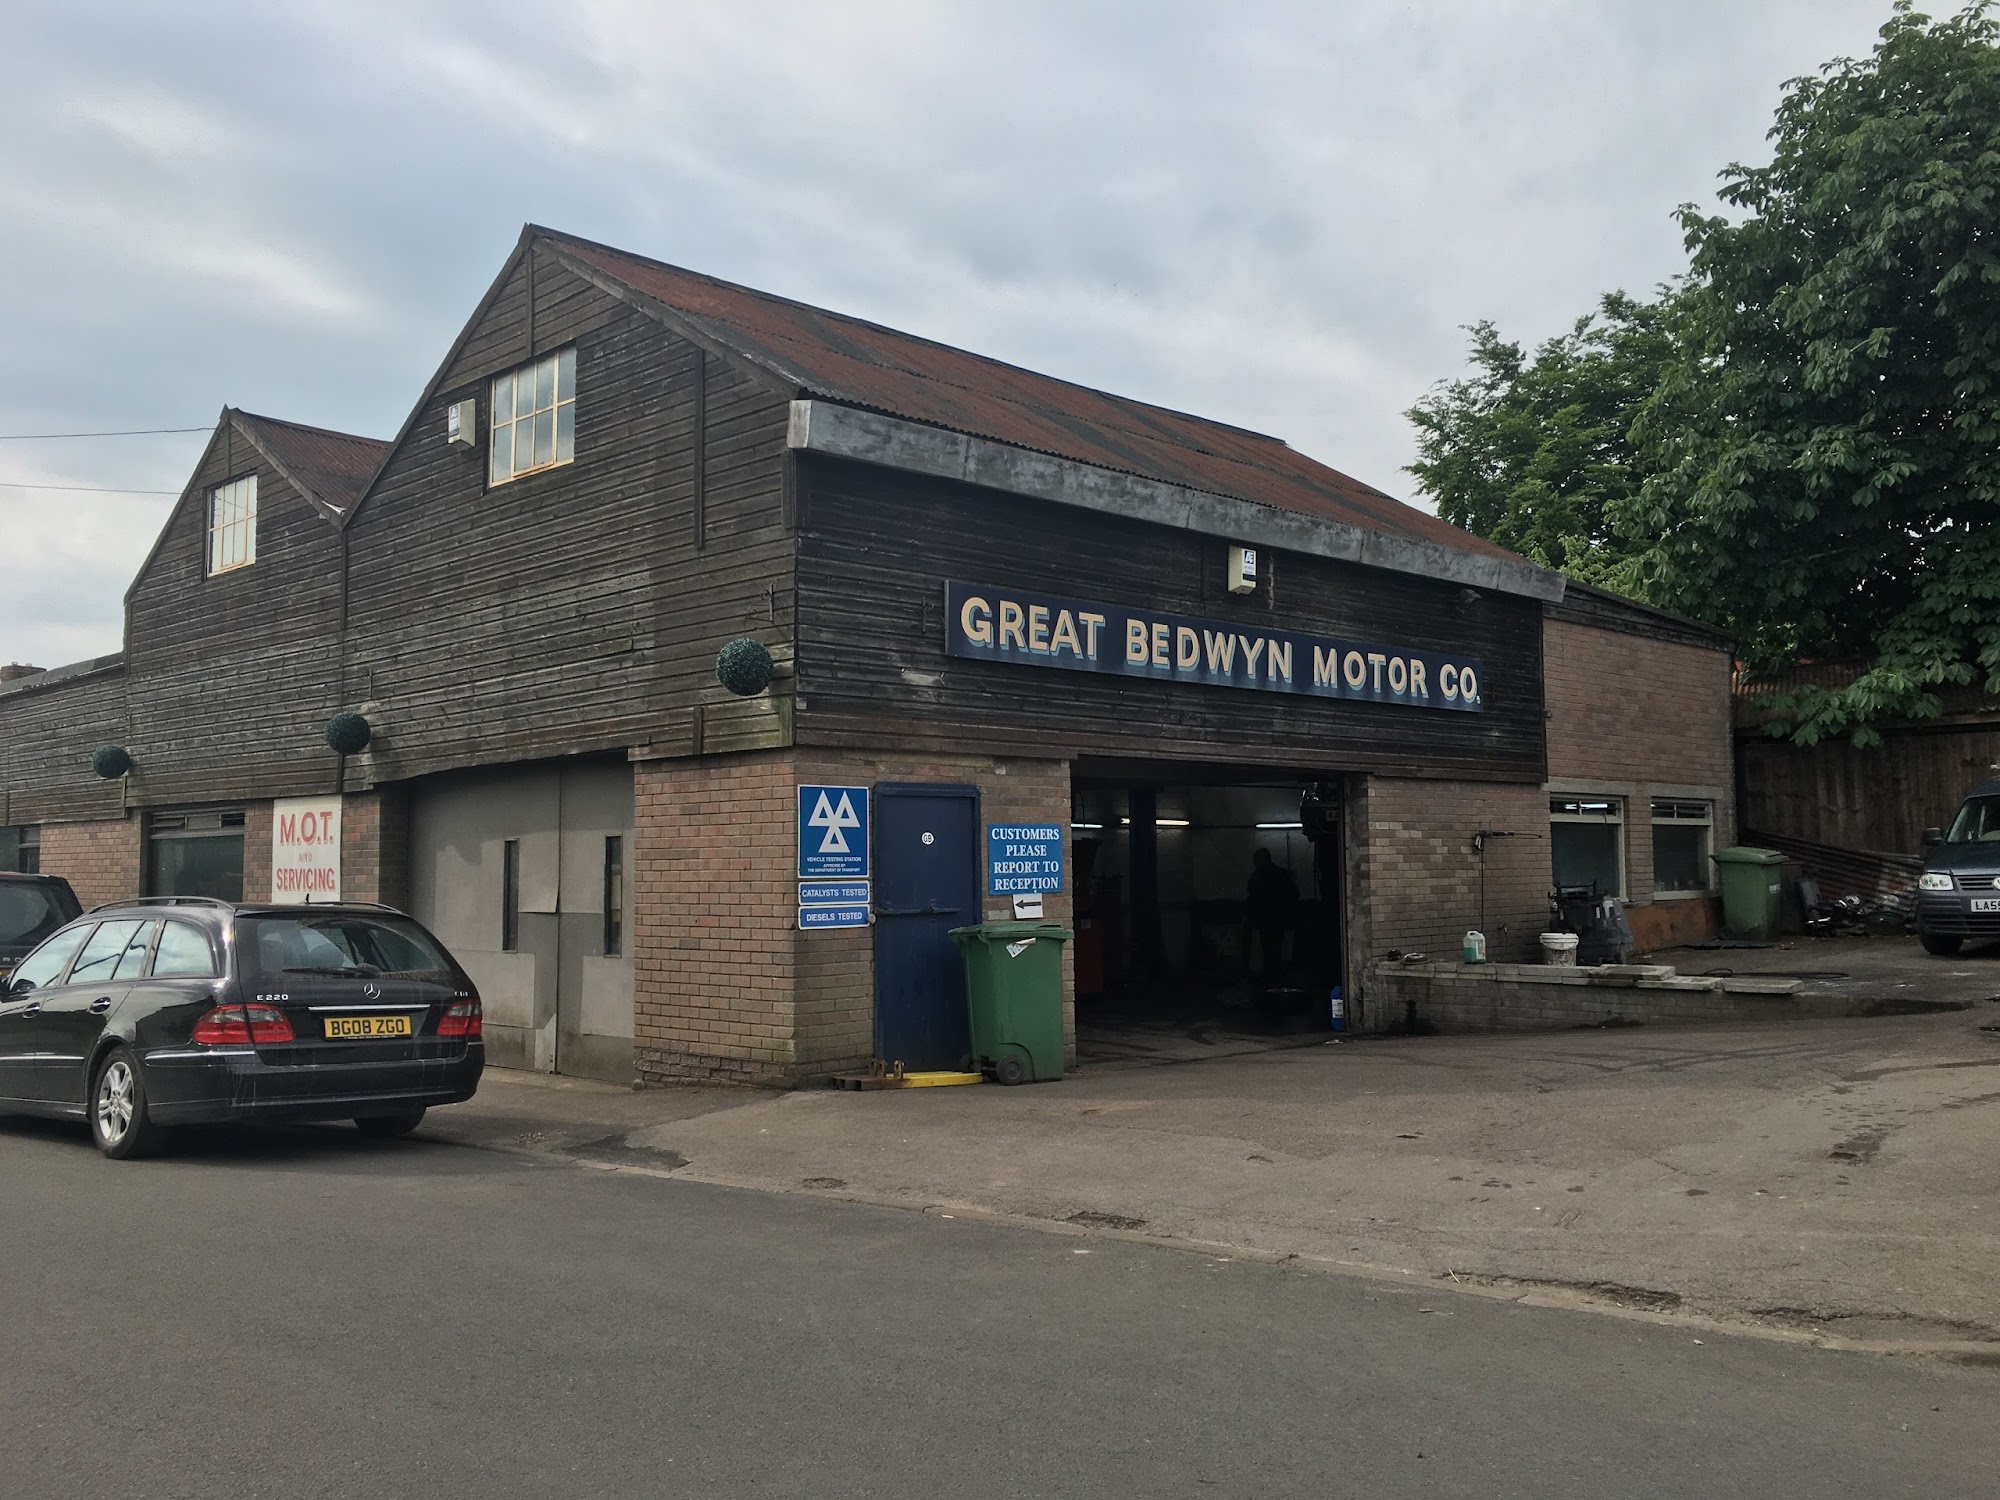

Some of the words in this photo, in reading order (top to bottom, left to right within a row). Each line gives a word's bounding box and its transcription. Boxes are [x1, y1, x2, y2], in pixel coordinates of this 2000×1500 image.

[961, 596, 1105, 660] GREAT
[1126, 618, 1292, 684] BEDWYN
[1313, 645, 1429, 699] MOTOR
[1439, 663, 1481, 704] CO.
[280, 811, 333, 845] M.O.T.
[991, 828, 1060, 840] CUSTOMERS
[923, 834, 933, 843] GB
[1006, 844, 1047, 856] PLEASE
[994, 861, 1040, 874] REPORT
[1043, 861, 1059, 873] TO
[276, 867, 335, 891] SERVICING
[994, 877, 1059, 891] RECEPTION
[801, 889, 839, 898] CATALYSTS
[841, 888, 867, 897] TESTED
[806, 912, 835, 922] DIESELS
[838, 911, 863, 921] TESTED
[331, 1020, 372, 1036] BG08
[375, 1018, 405, 1034] ZGO
